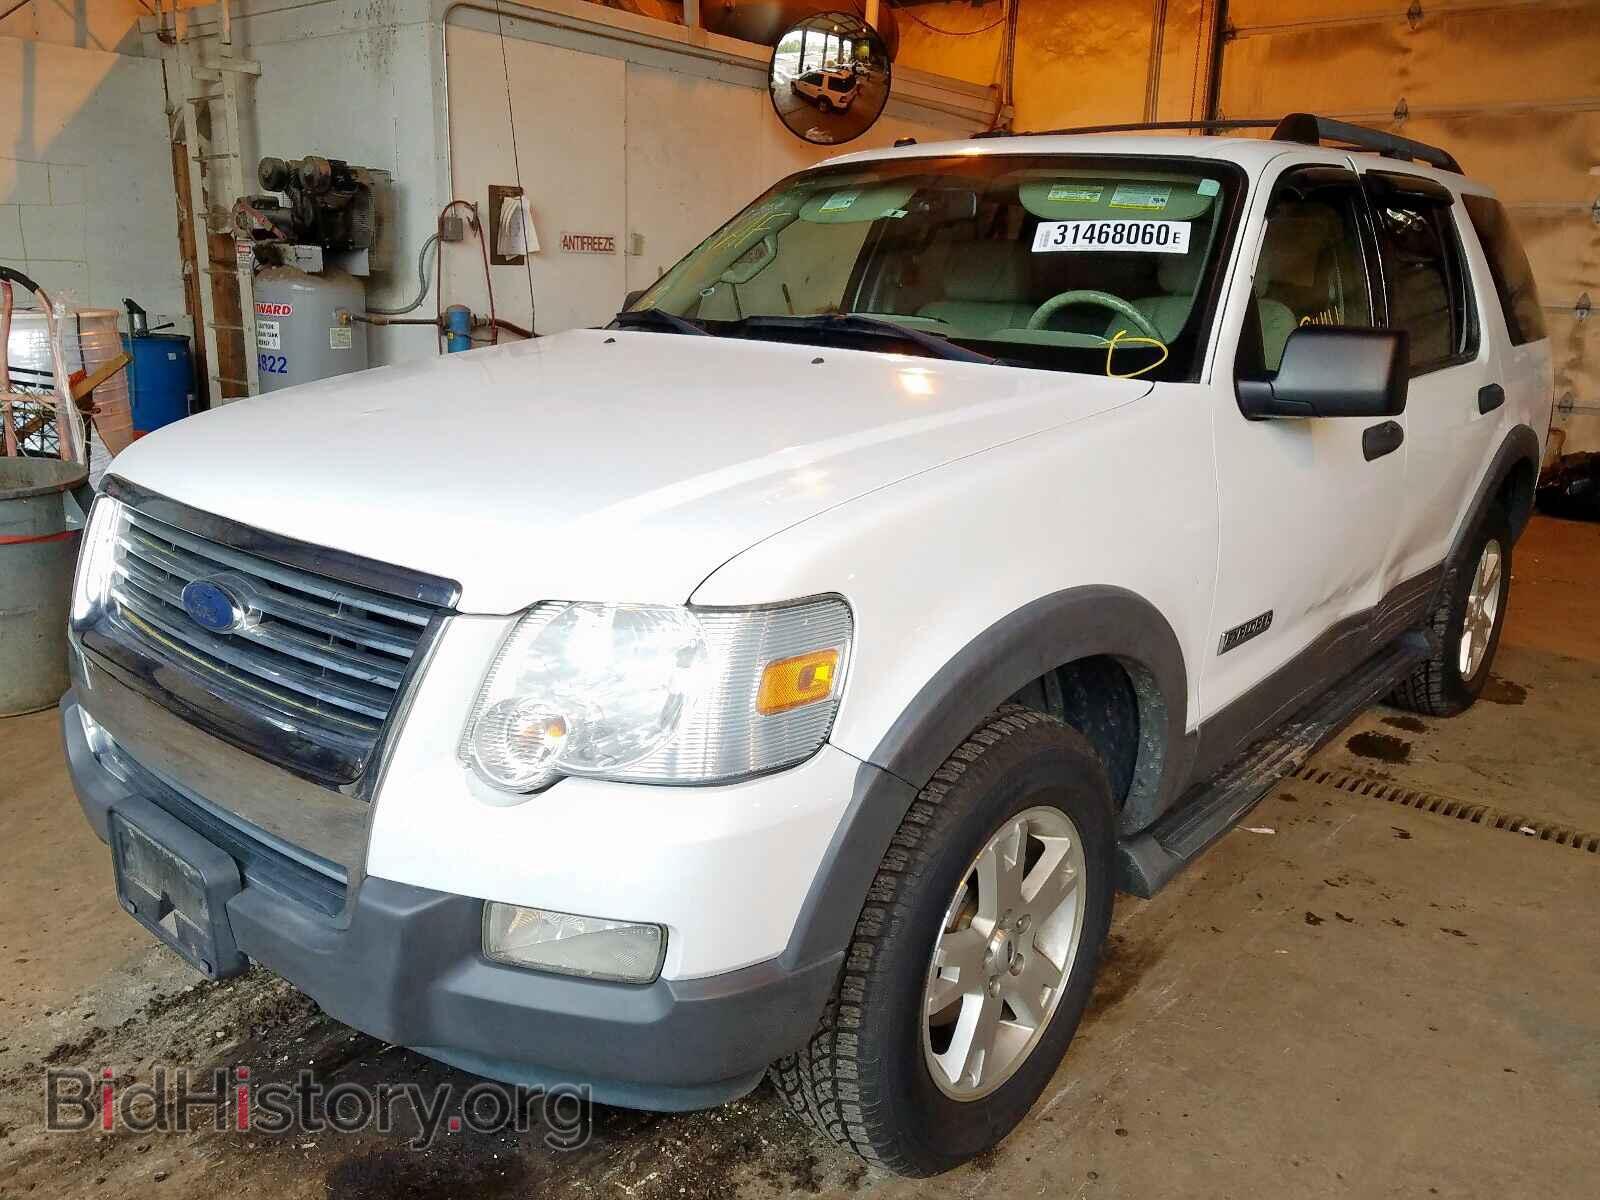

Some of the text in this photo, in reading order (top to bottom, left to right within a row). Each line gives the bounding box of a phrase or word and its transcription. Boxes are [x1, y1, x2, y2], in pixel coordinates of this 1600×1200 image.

[562, 235, 615, 251] ANTIFREEZE
[1053, 223, 1170, 246] 31468060
[258, 352, 288, 374] 822
